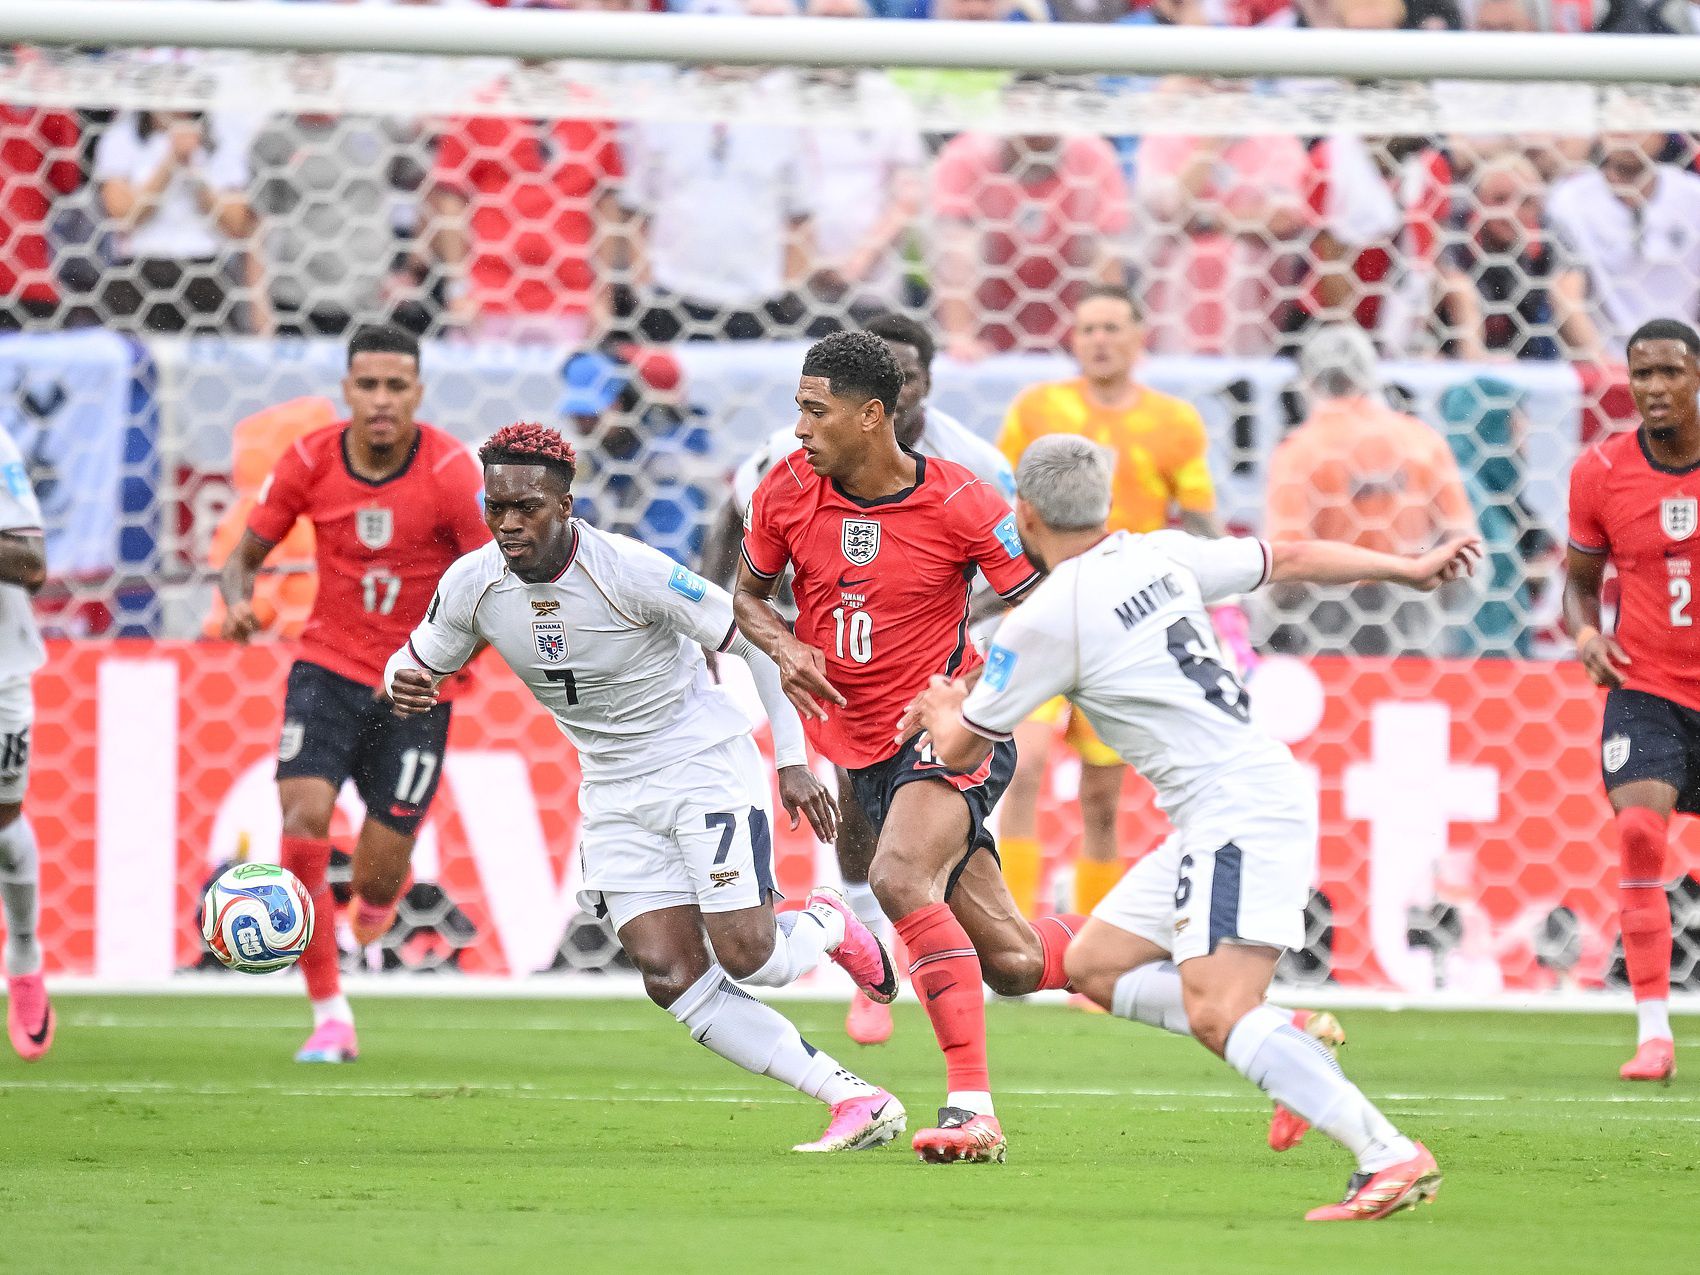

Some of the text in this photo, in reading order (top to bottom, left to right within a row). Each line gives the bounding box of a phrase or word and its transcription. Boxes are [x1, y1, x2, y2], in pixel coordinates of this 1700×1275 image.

[361, 567, 402, 615] 17
[531, 601, 560, 609] Reebok
[1668, 577, 1692, 627] 2
[832, 607, 873, 664] 10
[543, 669, 579, 705] 7
[1166, 616, 1250, 723] 6
[394, 748, 438, 804] 17
[705, 813, 736, 865] 7
[710, 870, 740, 880] Reebok
